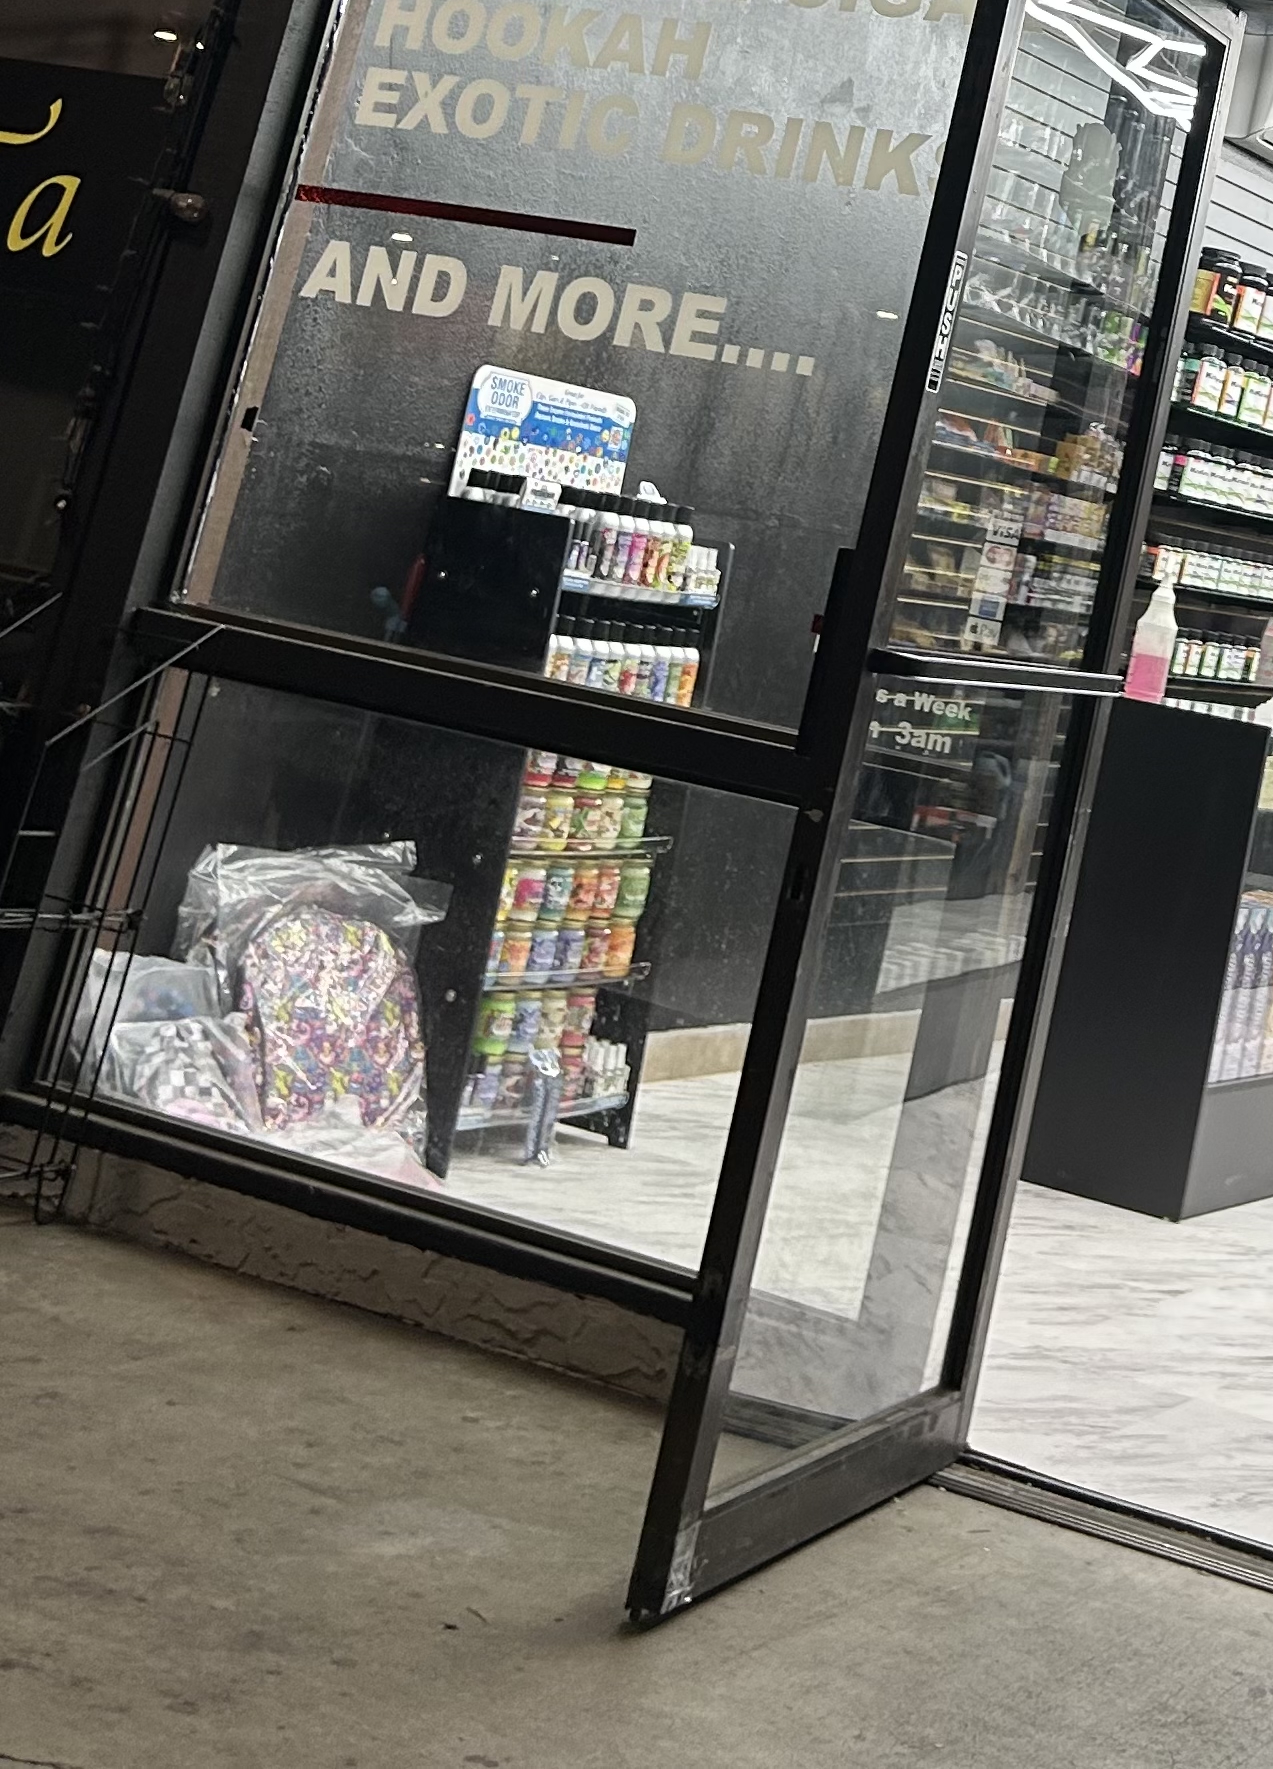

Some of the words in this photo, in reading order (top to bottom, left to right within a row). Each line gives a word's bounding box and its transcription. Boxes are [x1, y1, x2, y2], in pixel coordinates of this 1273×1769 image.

[354, 67, 641, 159] EXOTIC
[657, 102, 947, 197] DRINK
[300, 240, 469, 320] AND
[936, 263, 963, 361] PUSH
[490, 375, 527, 397] SMOKE
[490, 391, 520, 409] ODOR
[914, 691, 973, 721] Week
[895, 721, 953, 754] 3am
